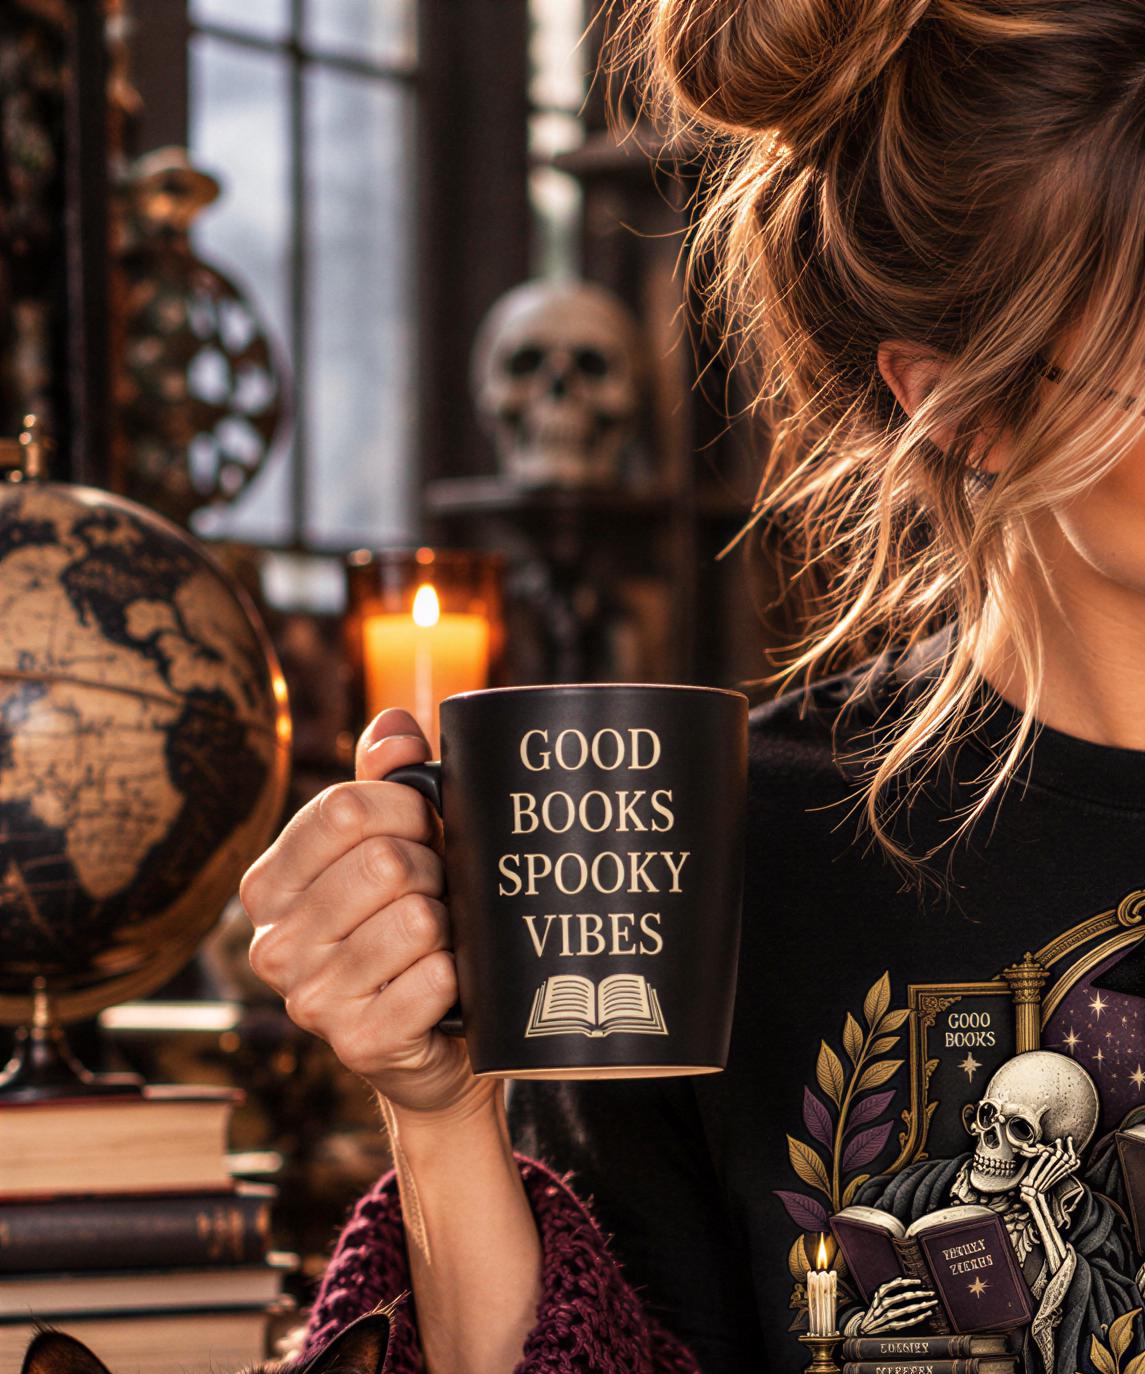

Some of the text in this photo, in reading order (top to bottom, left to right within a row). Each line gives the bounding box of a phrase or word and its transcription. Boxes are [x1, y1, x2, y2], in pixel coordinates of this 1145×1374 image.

[520, 728, 661, 772] GOOD
[509, 789, 674, 834] BOOKS
[498, 851, 691, 896] SPOOKY
[522, 912, 663, 958] VIBES
[945, 1031, 996, 1048] BOOKS
